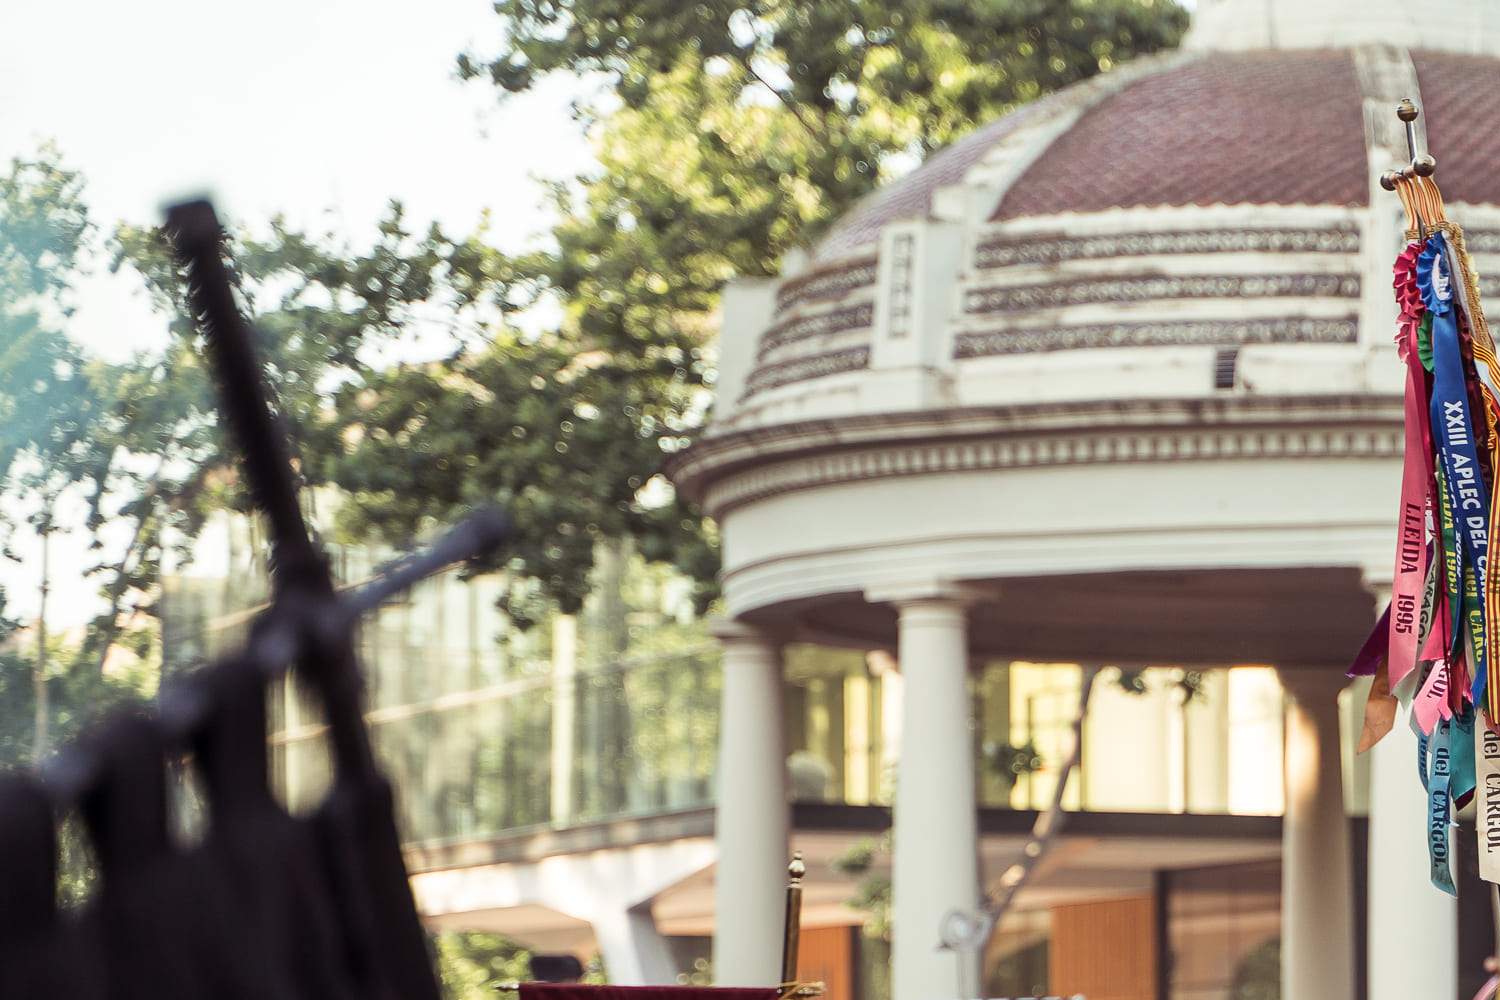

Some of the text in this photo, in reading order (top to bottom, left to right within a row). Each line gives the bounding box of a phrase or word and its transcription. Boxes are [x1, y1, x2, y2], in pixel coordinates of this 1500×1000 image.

[1443, 400, 1469, 447] XXIII
[1451, 453, 1482, 512] APLEC
[1465, 515, 1487, 549] DEL
[1395, 503, 1422, 635] LLEIDA 1995
[1434, 747, 1450, 777] del
[1430, 789, 1449, 867] CARGOL
